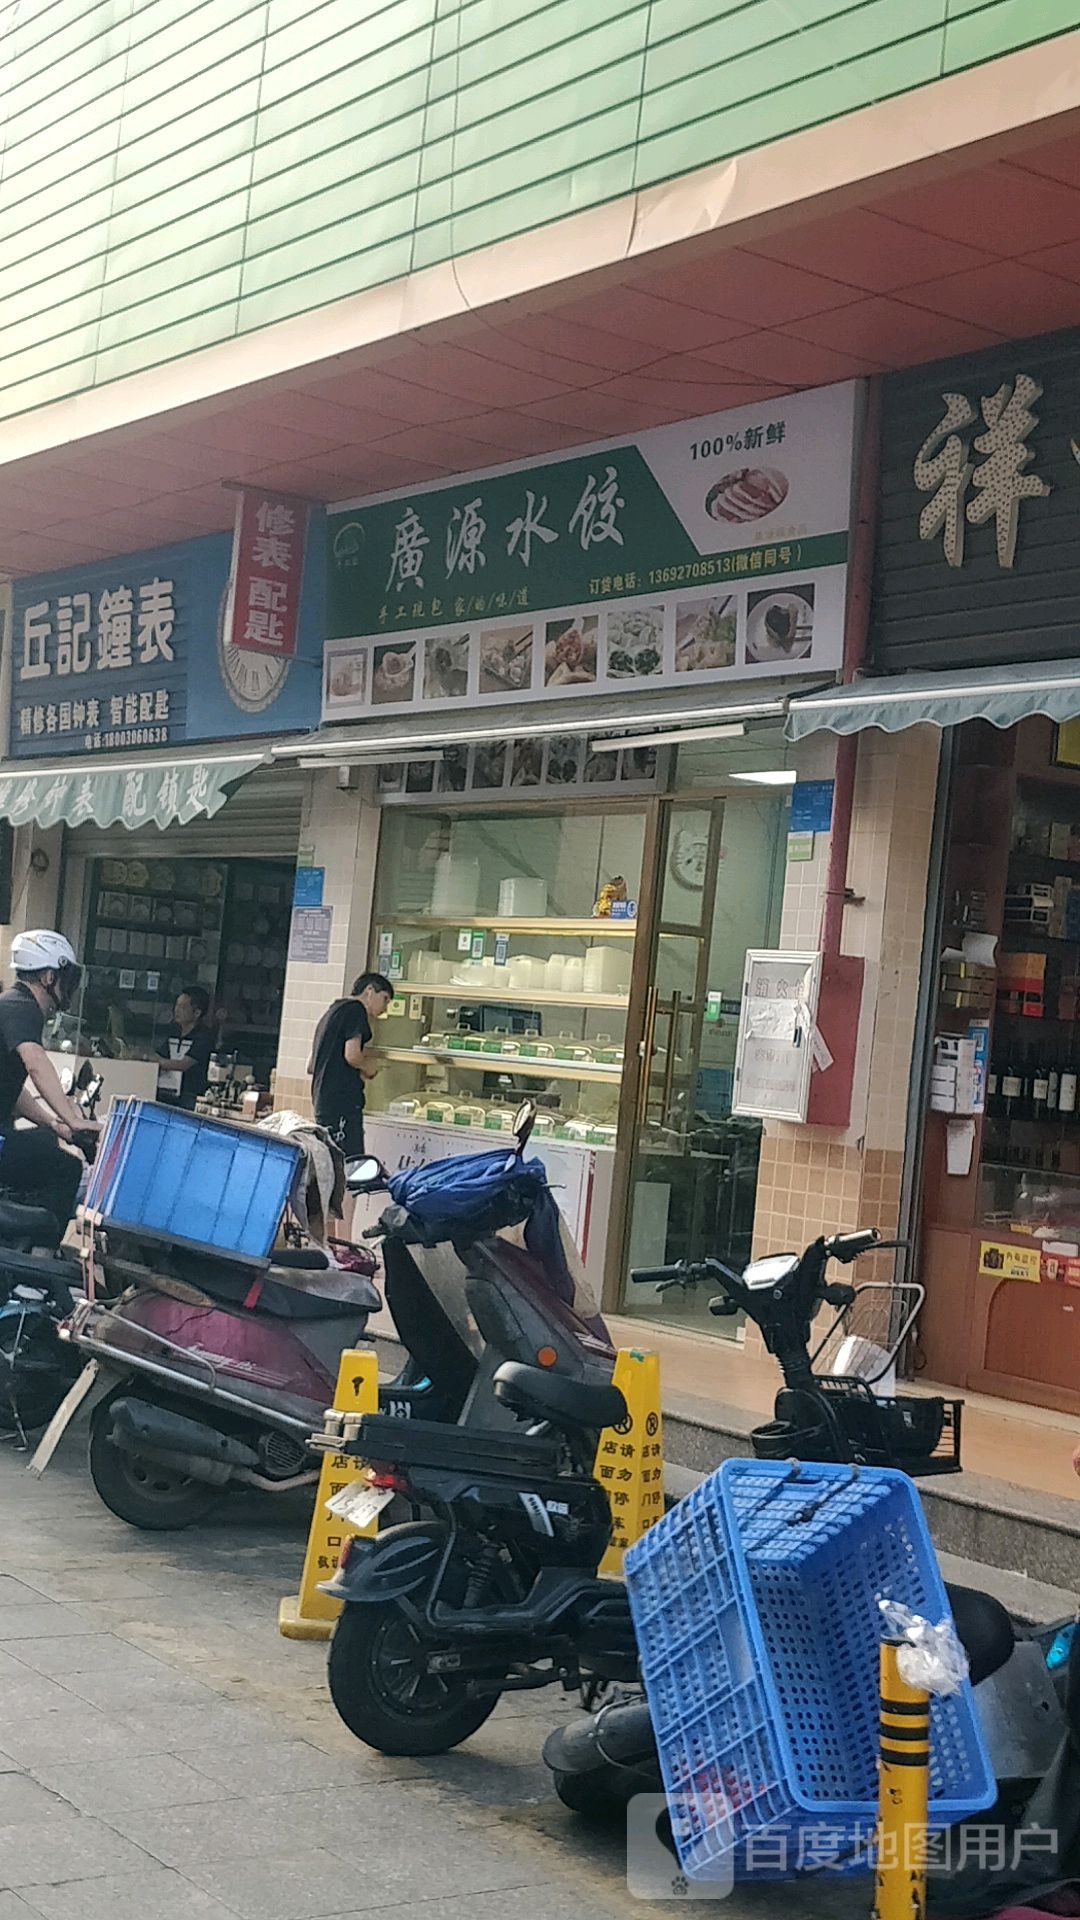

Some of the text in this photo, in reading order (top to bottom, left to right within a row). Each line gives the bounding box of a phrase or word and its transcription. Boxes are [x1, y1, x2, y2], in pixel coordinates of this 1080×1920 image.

[690, 421, 786, 460] 100%新鲜
[913, 373, 1080, 568] 祥
[385, 464, 626, 593] 廣源水饺
[377, 597, 443, 624] 手工现包
[111, 688, 169, 726] 智能配匙
